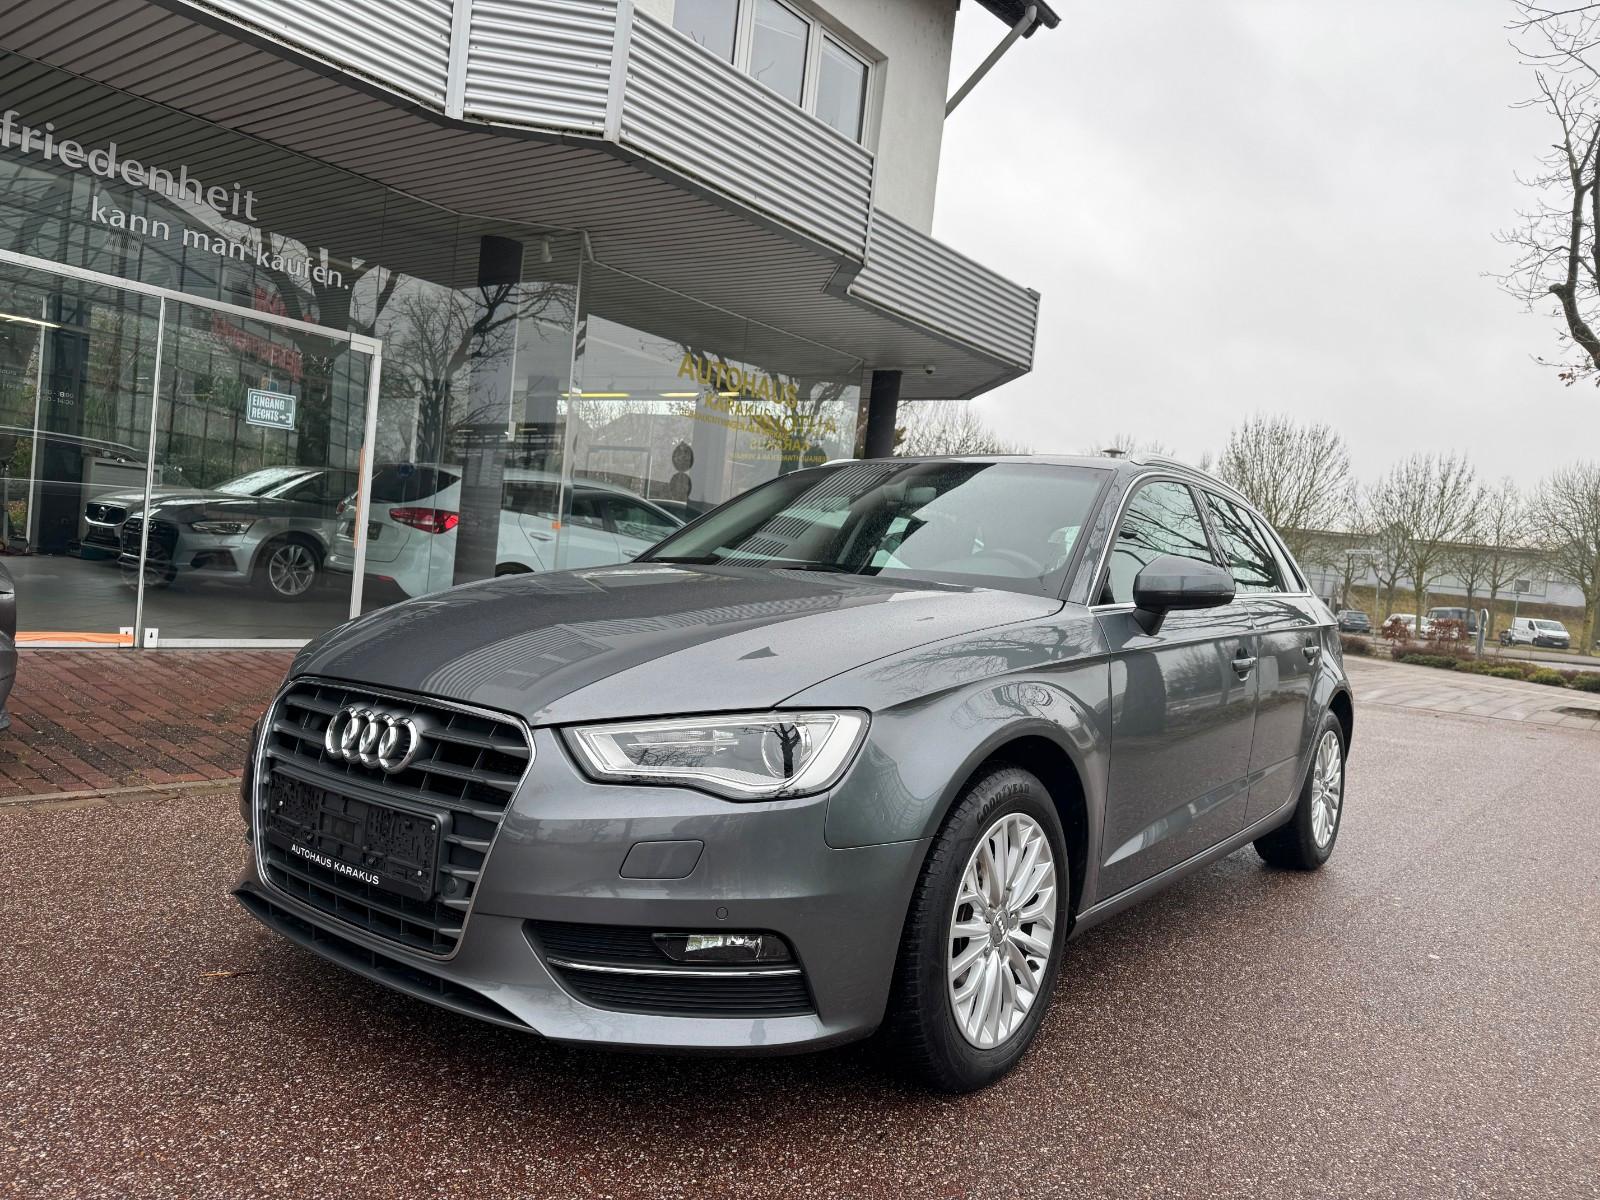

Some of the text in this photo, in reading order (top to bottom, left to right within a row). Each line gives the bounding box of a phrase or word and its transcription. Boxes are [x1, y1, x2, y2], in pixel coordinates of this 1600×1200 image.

[0, 110, 258, 221] friedenheit
[91, 195, 349, 290] kann man kaufen.
[252, 395, 285, 410] EINGANG
[677, 351, 799, 409] AUTOHAUS
[251, 407, 279, 421] RECHTS
[291, 844, 380, 885] AUTOHAUS KARAKUS
